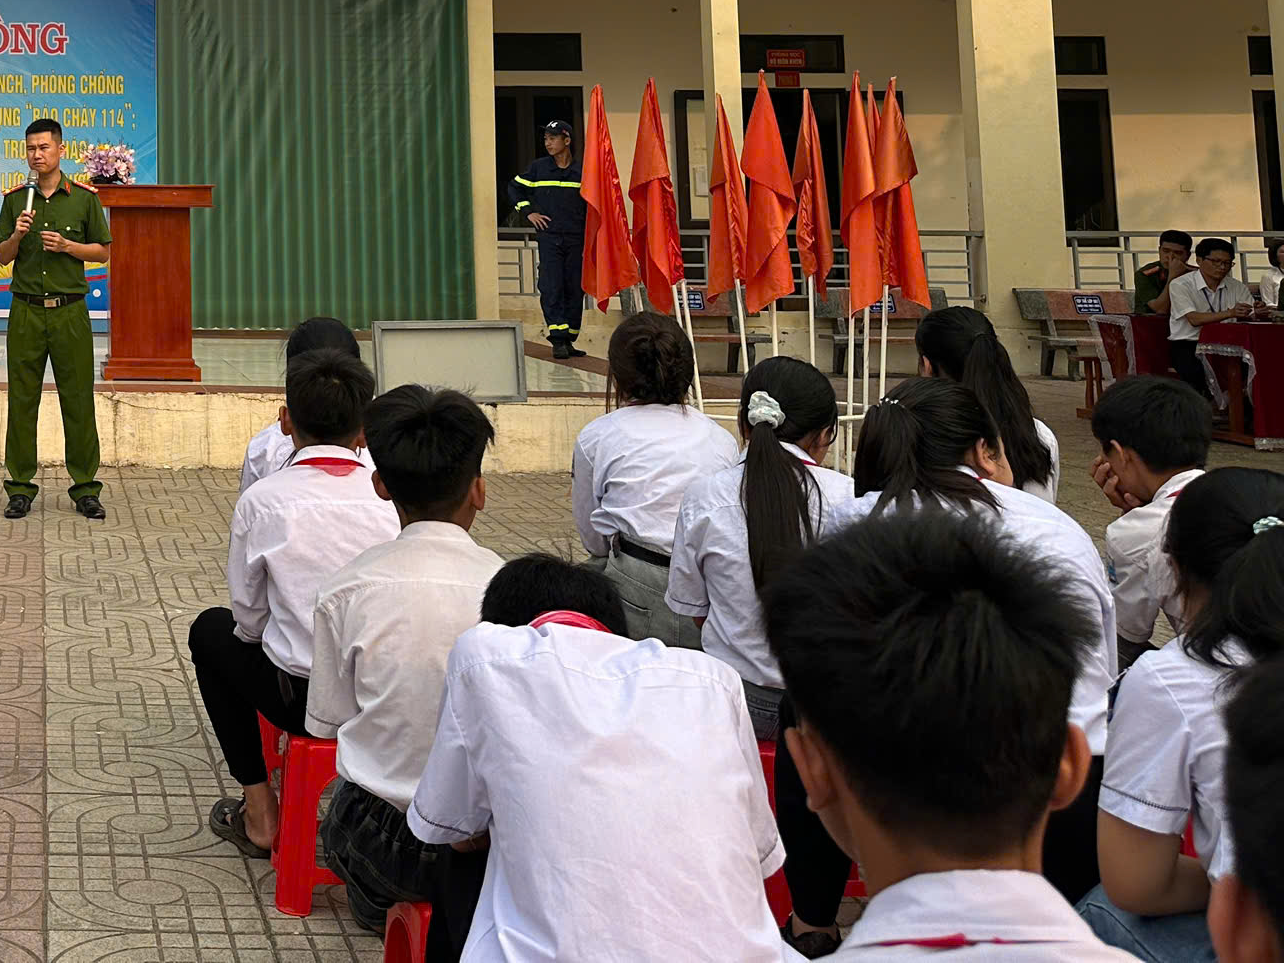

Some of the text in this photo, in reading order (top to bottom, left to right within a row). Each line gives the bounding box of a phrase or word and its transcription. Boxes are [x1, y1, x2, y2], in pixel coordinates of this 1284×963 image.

[31, 70, 76, 94] PHÒNG
[80, 68, 124, 95] CHỐNG
[63, 104, 97, 127] CHÁY
